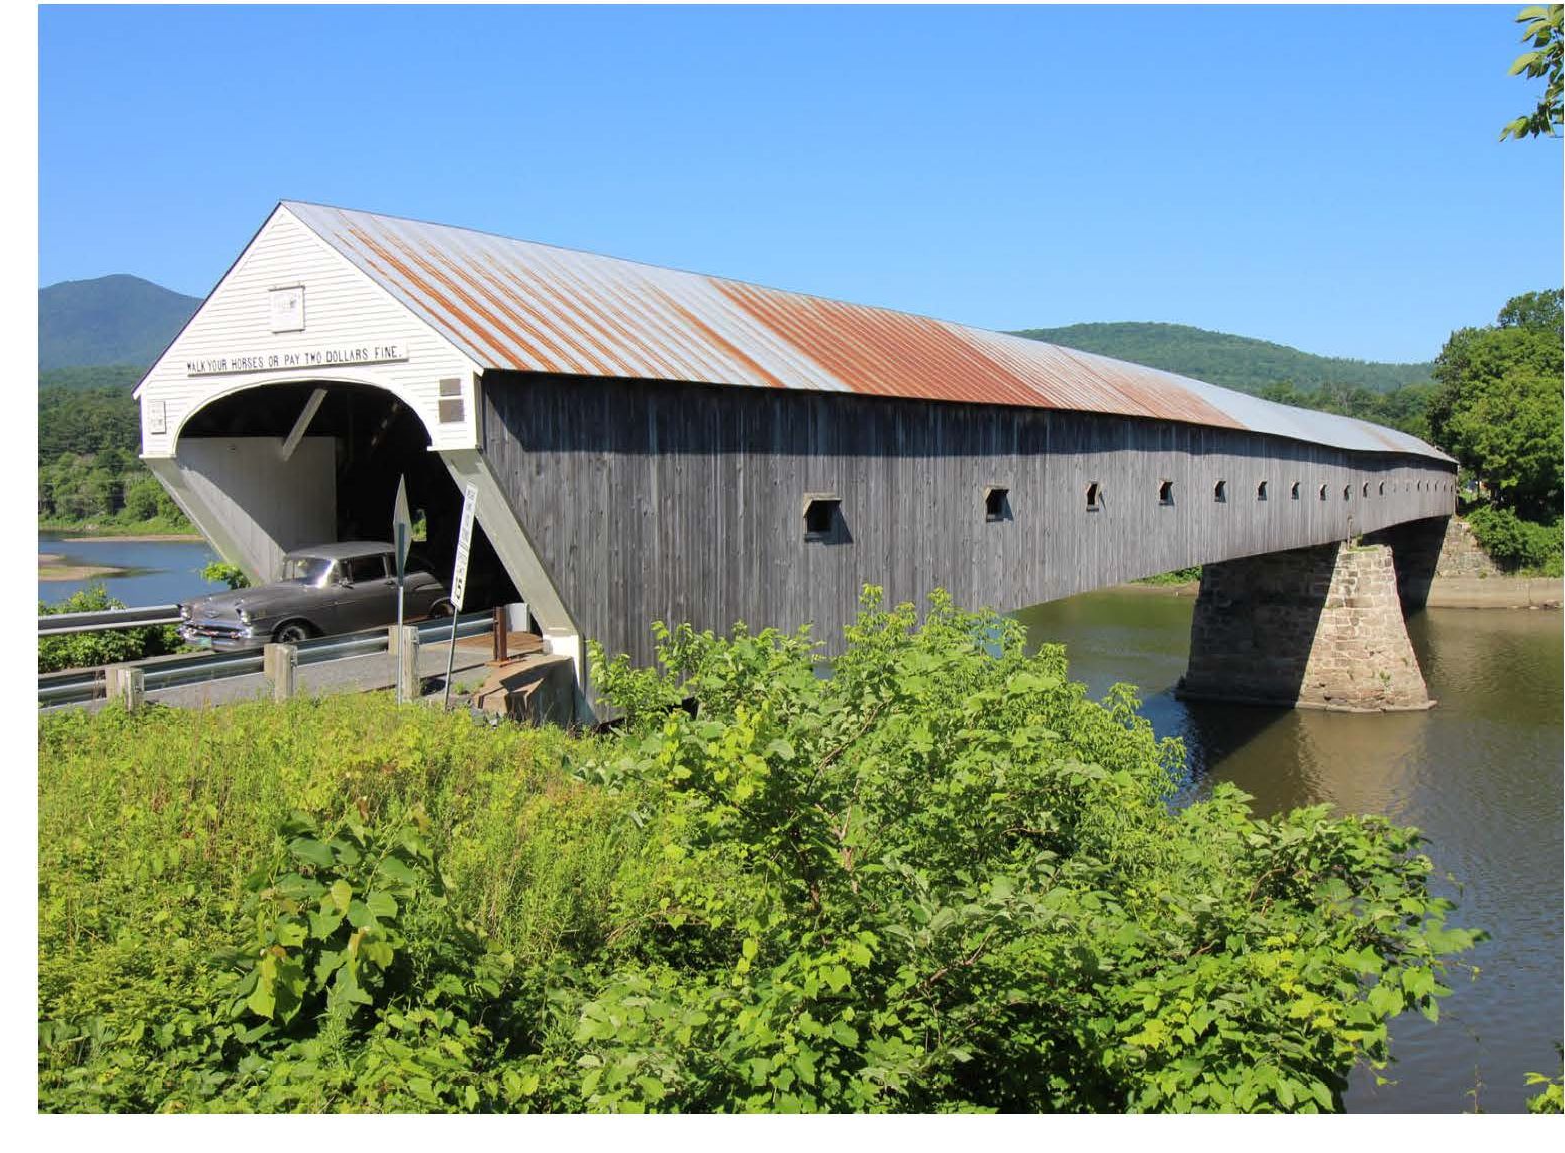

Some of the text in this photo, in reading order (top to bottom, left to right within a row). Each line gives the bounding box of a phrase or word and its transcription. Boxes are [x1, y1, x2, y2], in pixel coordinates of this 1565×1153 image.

[187, 345, 403, 373] WALK YOUR HORSES OR PAY TWO DOLLARS FINE.
